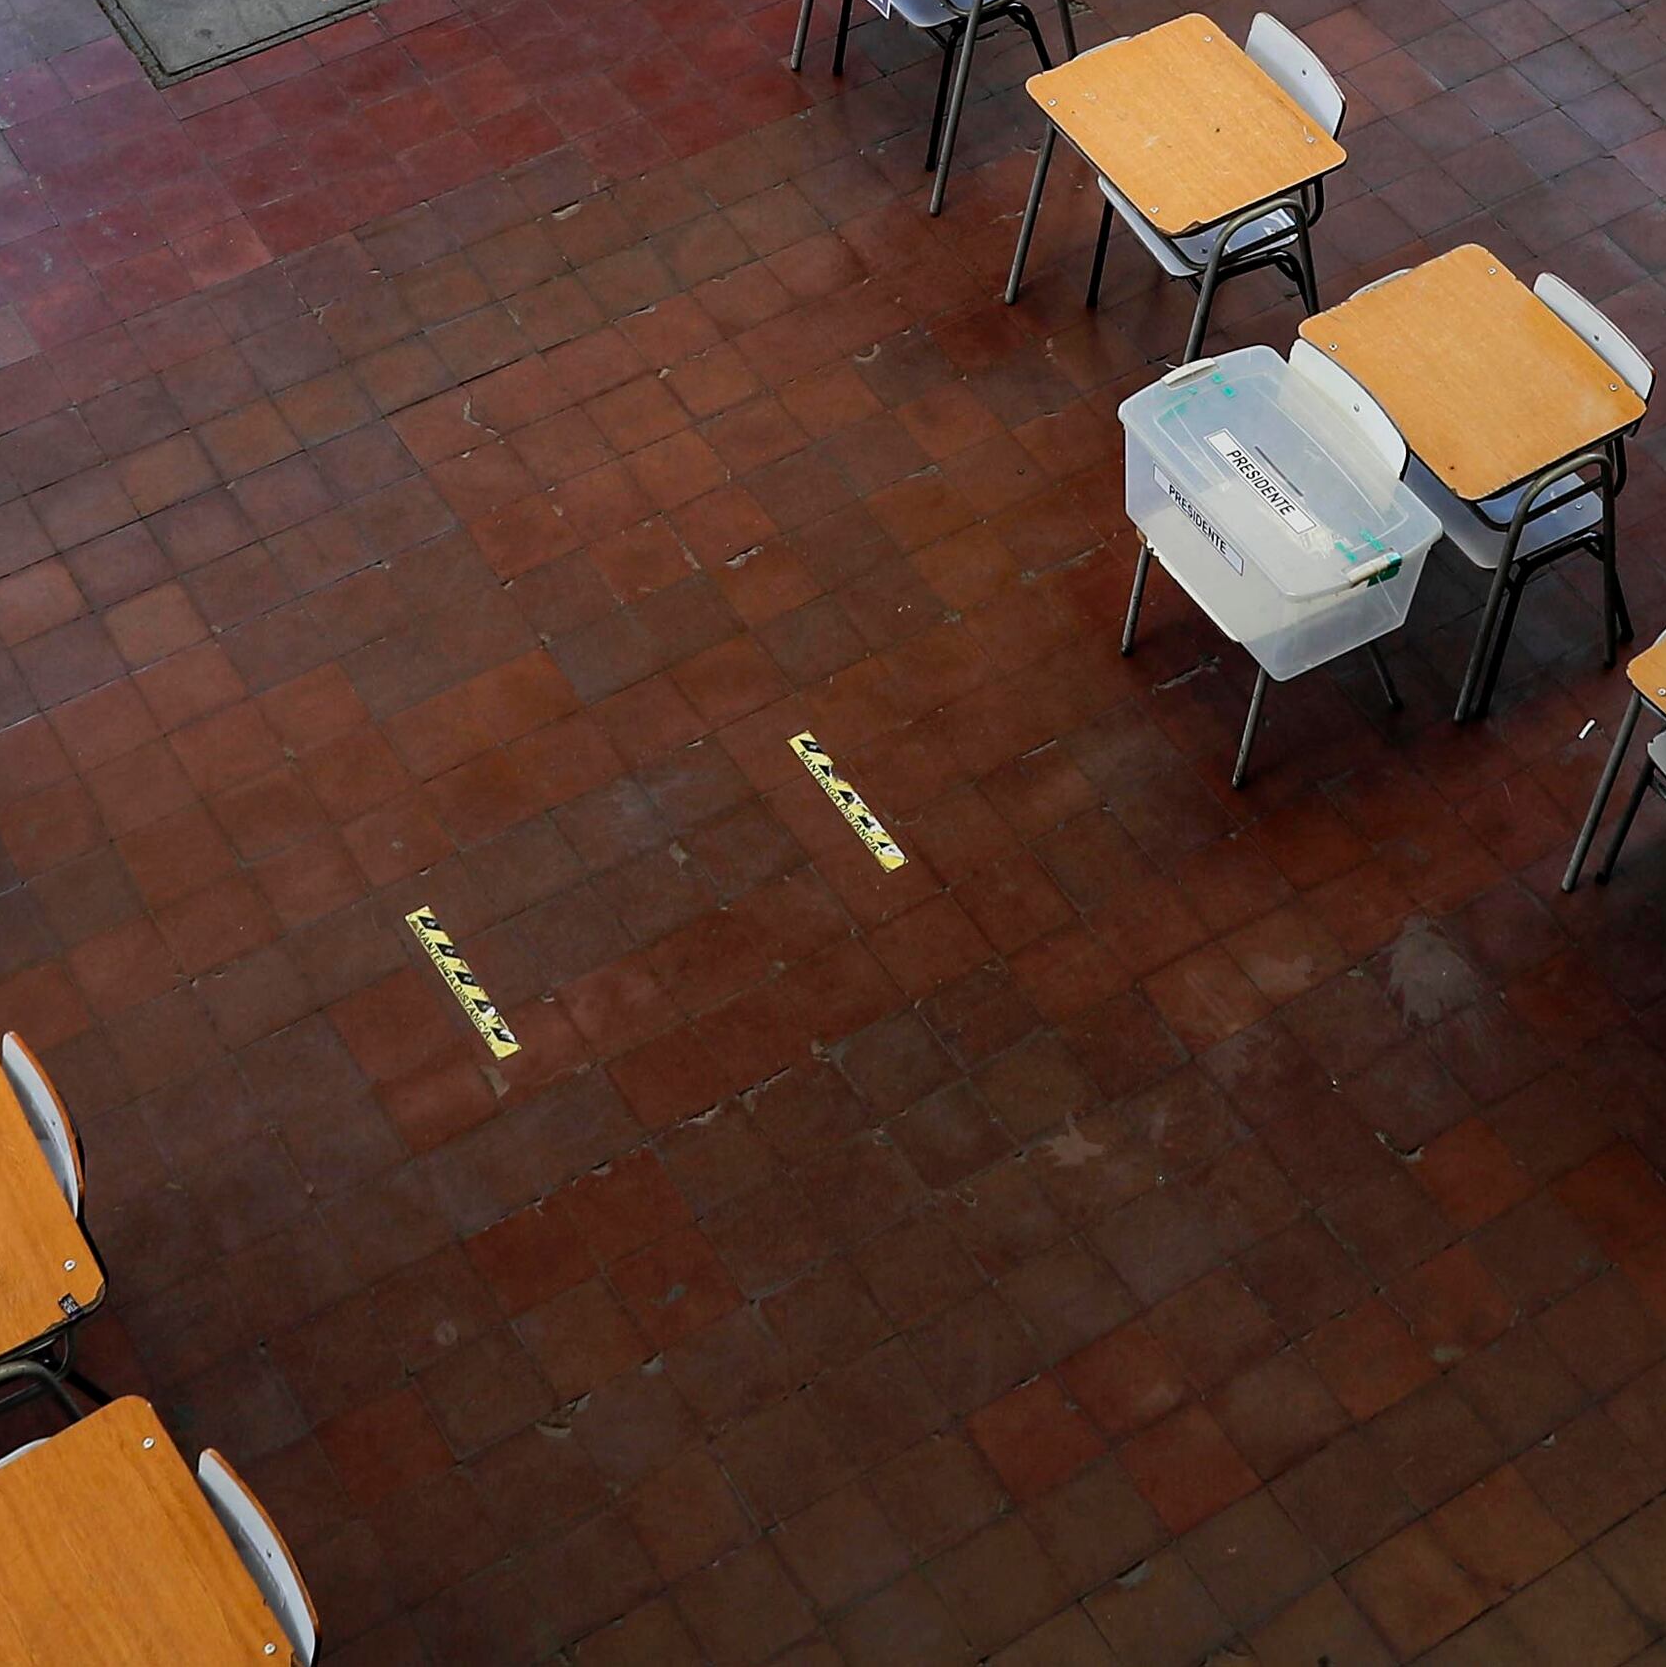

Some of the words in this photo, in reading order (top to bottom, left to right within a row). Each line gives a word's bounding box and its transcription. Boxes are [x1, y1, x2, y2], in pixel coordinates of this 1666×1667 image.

[1168, 484, 1228, 555] PRESIDENTE
[1226, 449, 1295, 517] PRESIDENTE
[798, 750, 841, 806] MANTENGA
[838, 803, 879, 853] DISTANCIA
[417, 926, 456, 987] MANTENGA
[453, 984, 493, 1039] DISTANCIA
